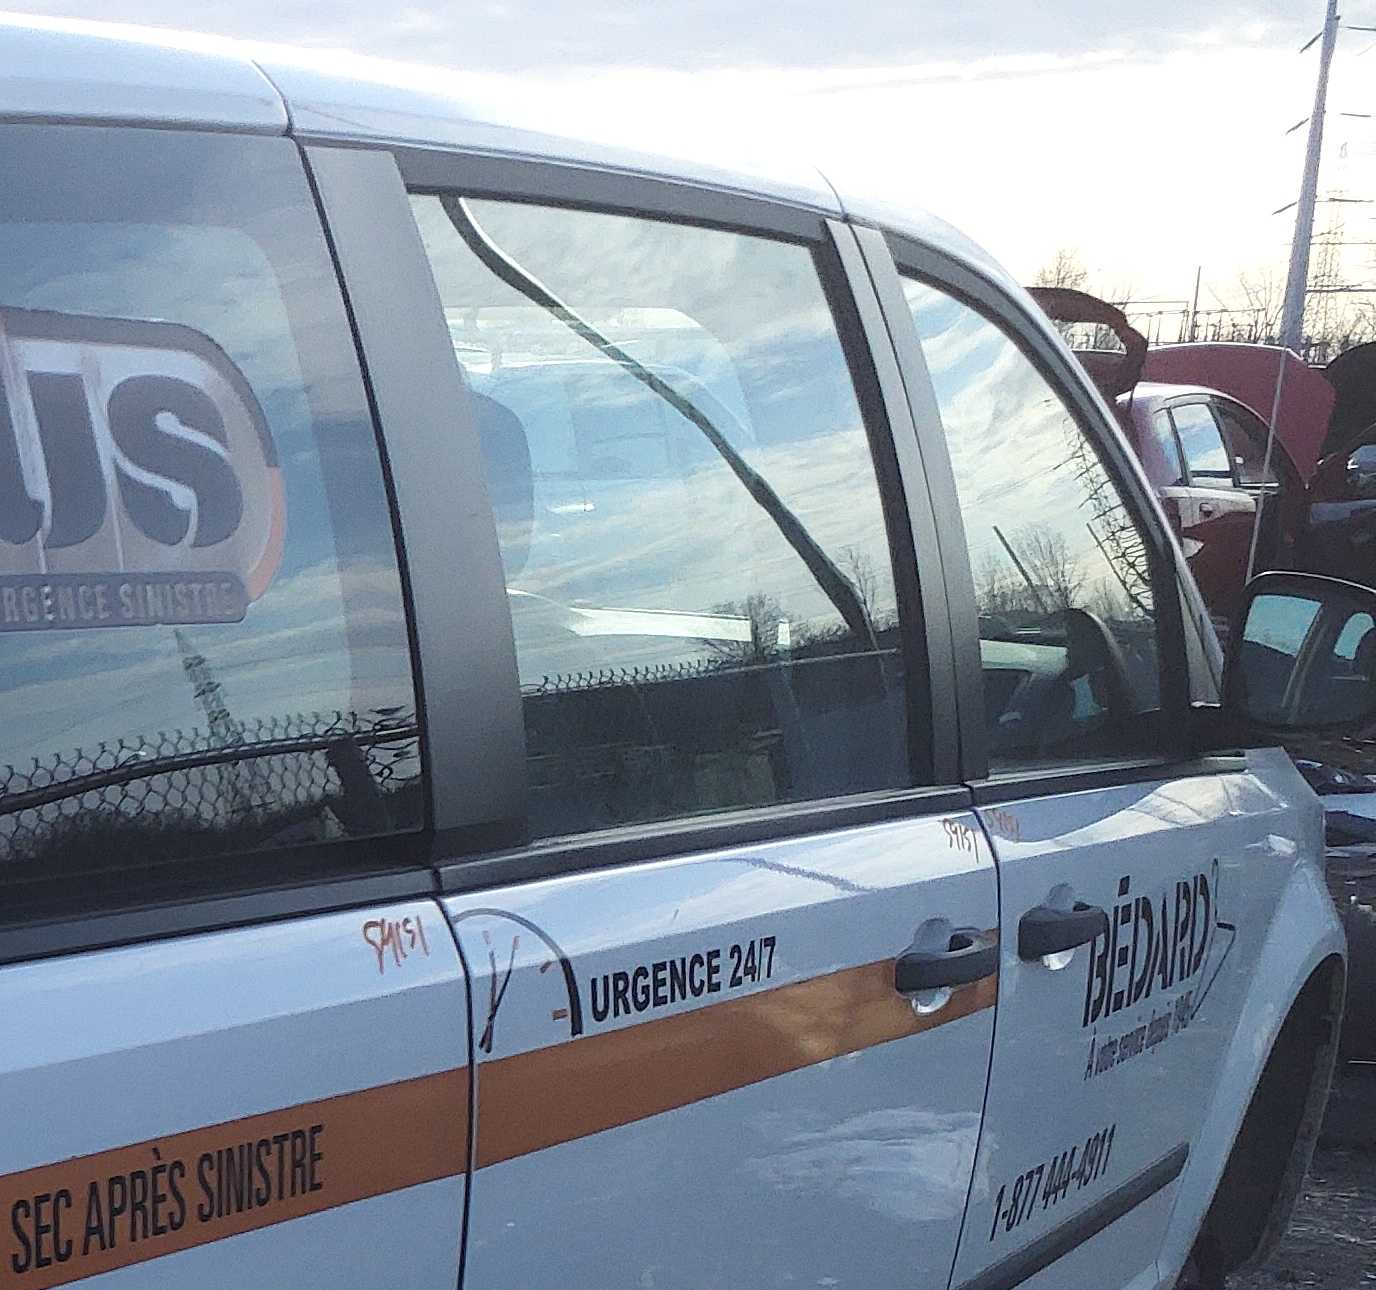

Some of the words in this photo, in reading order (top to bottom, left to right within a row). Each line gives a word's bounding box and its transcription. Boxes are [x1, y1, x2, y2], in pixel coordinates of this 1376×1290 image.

[119, 582, 234, 618] SINISTRE
[590, 948, 721, 1021] URGENCE
[729, 936, 777, 995] 24/7
[11, 1188, 73, 1274] SEC
[83, 1148, 186, 1255] APRÈS
[197, 1124, 324, 1222] SINISTRE
